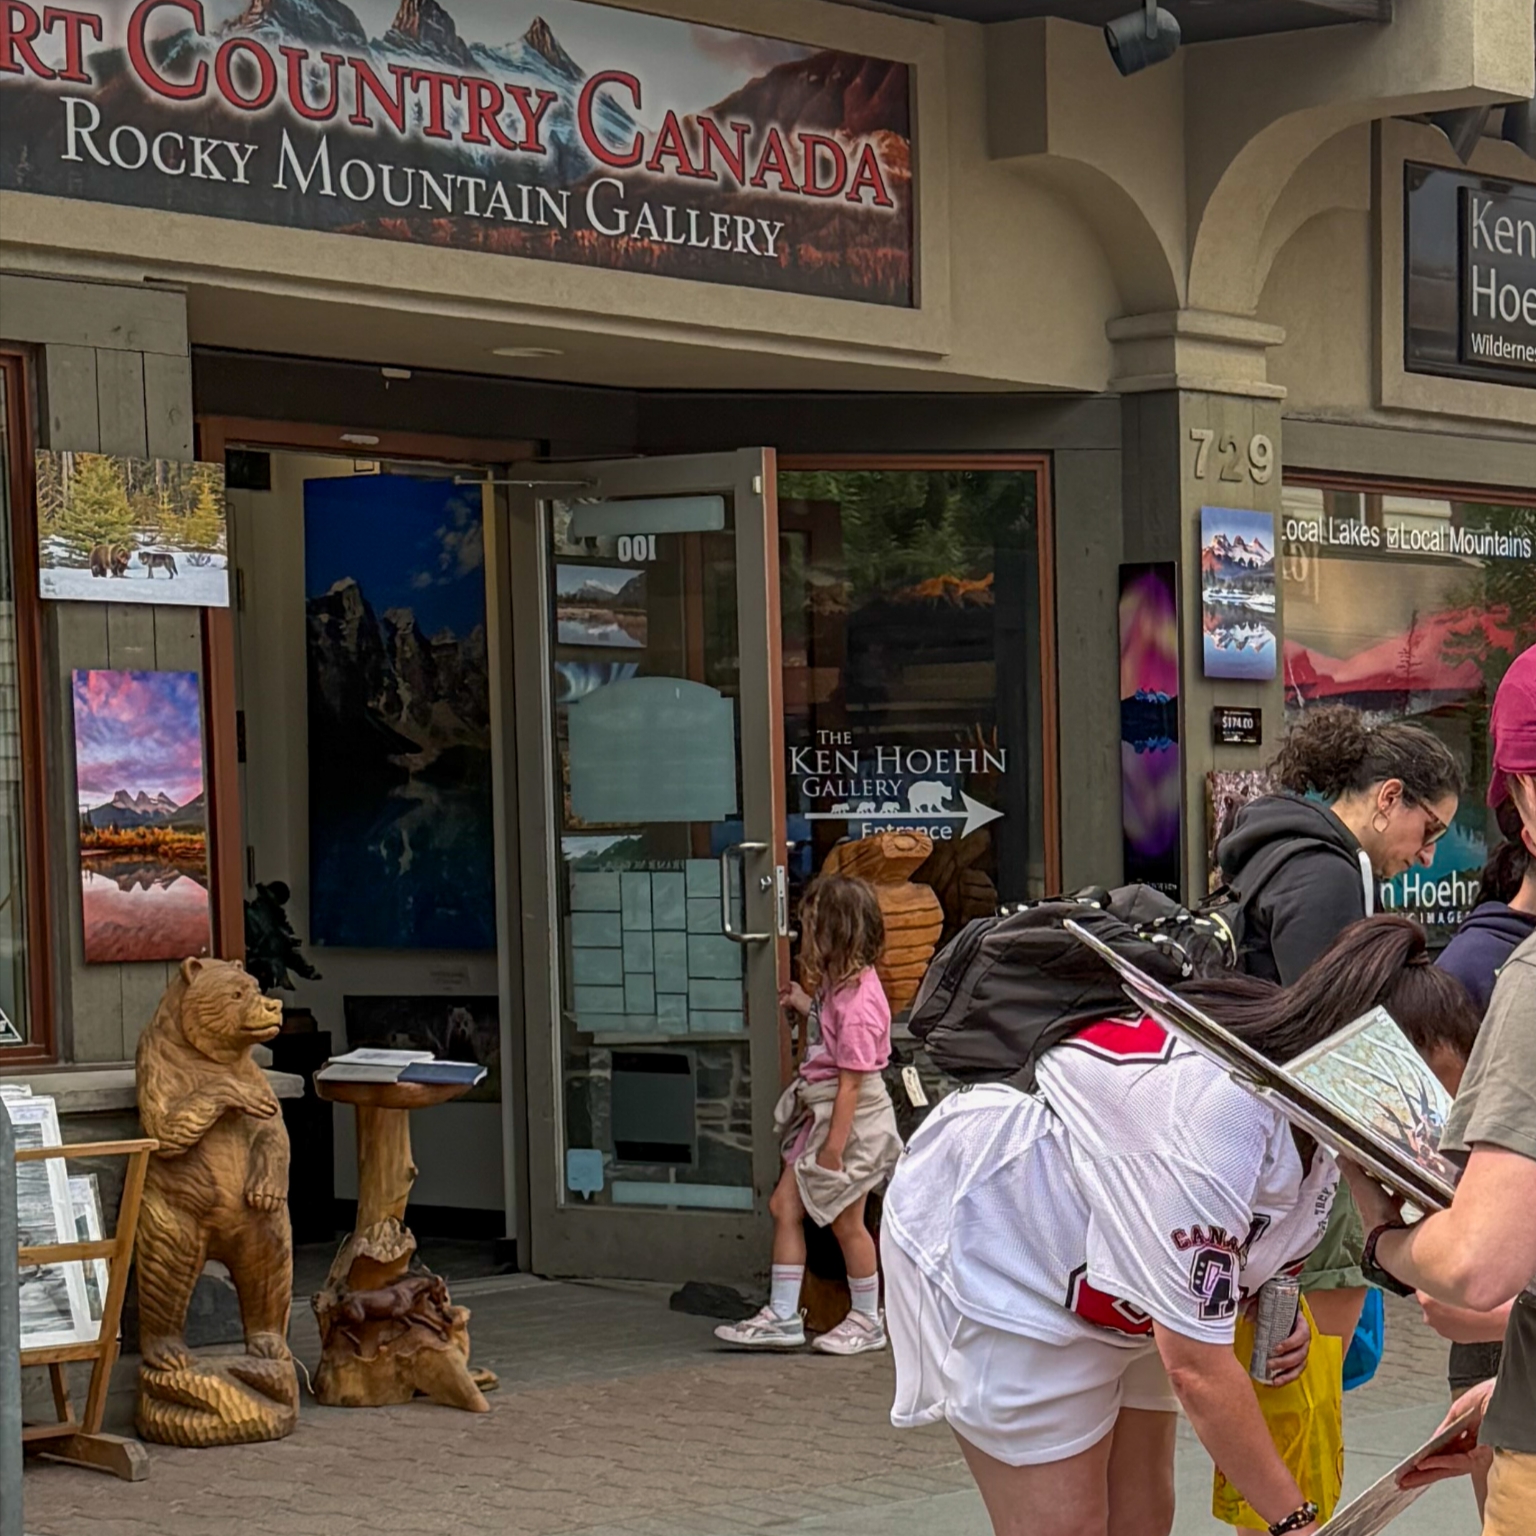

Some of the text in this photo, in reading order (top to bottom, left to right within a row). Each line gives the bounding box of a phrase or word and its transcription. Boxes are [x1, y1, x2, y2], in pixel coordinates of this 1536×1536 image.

[127, 0, 557, 153] COUNTRY
[577, 71, 895, 207] CANADA
[60, 97, 785, 258] ROCKY MOUNTAIN GALLERY
[1471, 197, 1536, 259] Ken
[1189, 428, 1273, 485] 729
[1282, 516, 1323, 543] ocal
[1329, 516, 1380, 547] Lakes
[1401, 522, 1444, 552] Local
[1450, 526, 1531, 558] Mountains
[789, 746, 1006, 775] KEN HOEHN
[817, 730, 852, 745] THE
[802, 777, 902, 797] GALLERY
